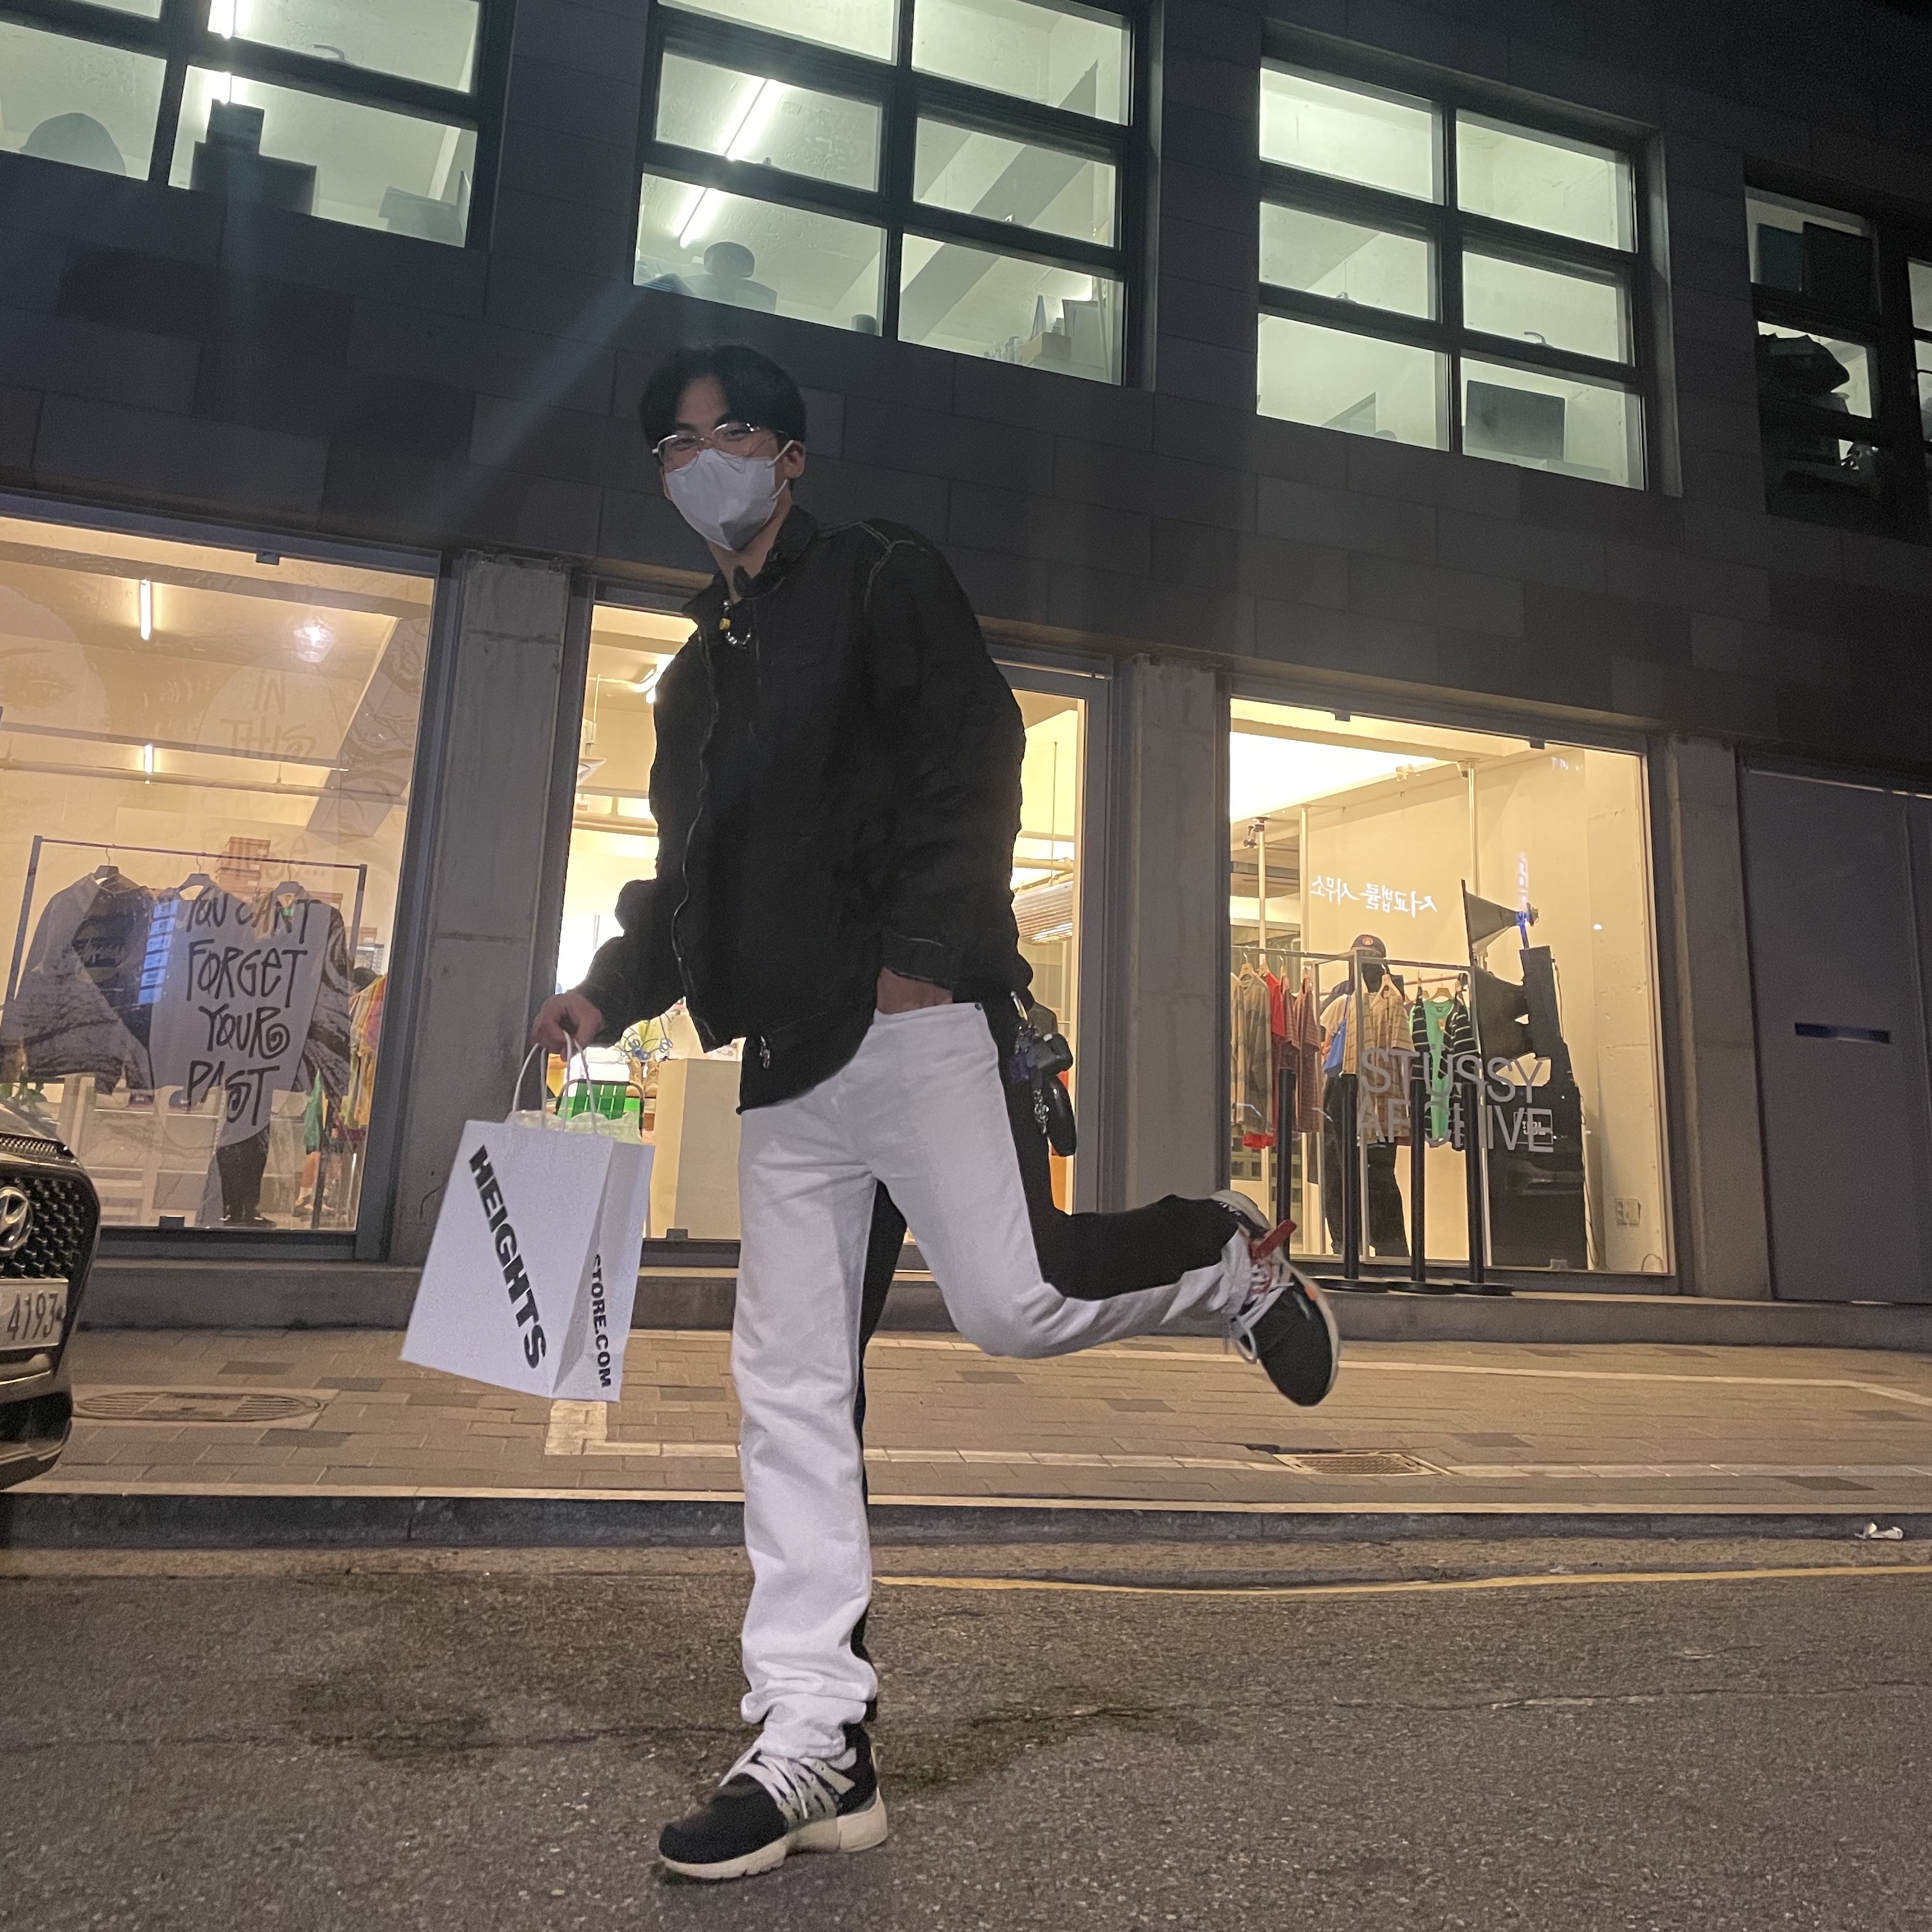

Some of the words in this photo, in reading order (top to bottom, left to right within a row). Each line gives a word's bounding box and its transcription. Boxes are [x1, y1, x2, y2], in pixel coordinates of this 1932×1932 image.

[253, 671, 286, 716] IN
[219, 716, 316, 758] THIS
[186, 885, 229, 933] YOU
[198, 1003, 291, 1060] YOUR
[187, 1060, 280, 1126] PAST
[469, 1144, 547, 1368] HEIGHTS
[7, 1292, 59, 1340] 4193
[591, 1254, 611, 1388] STORE.COM
